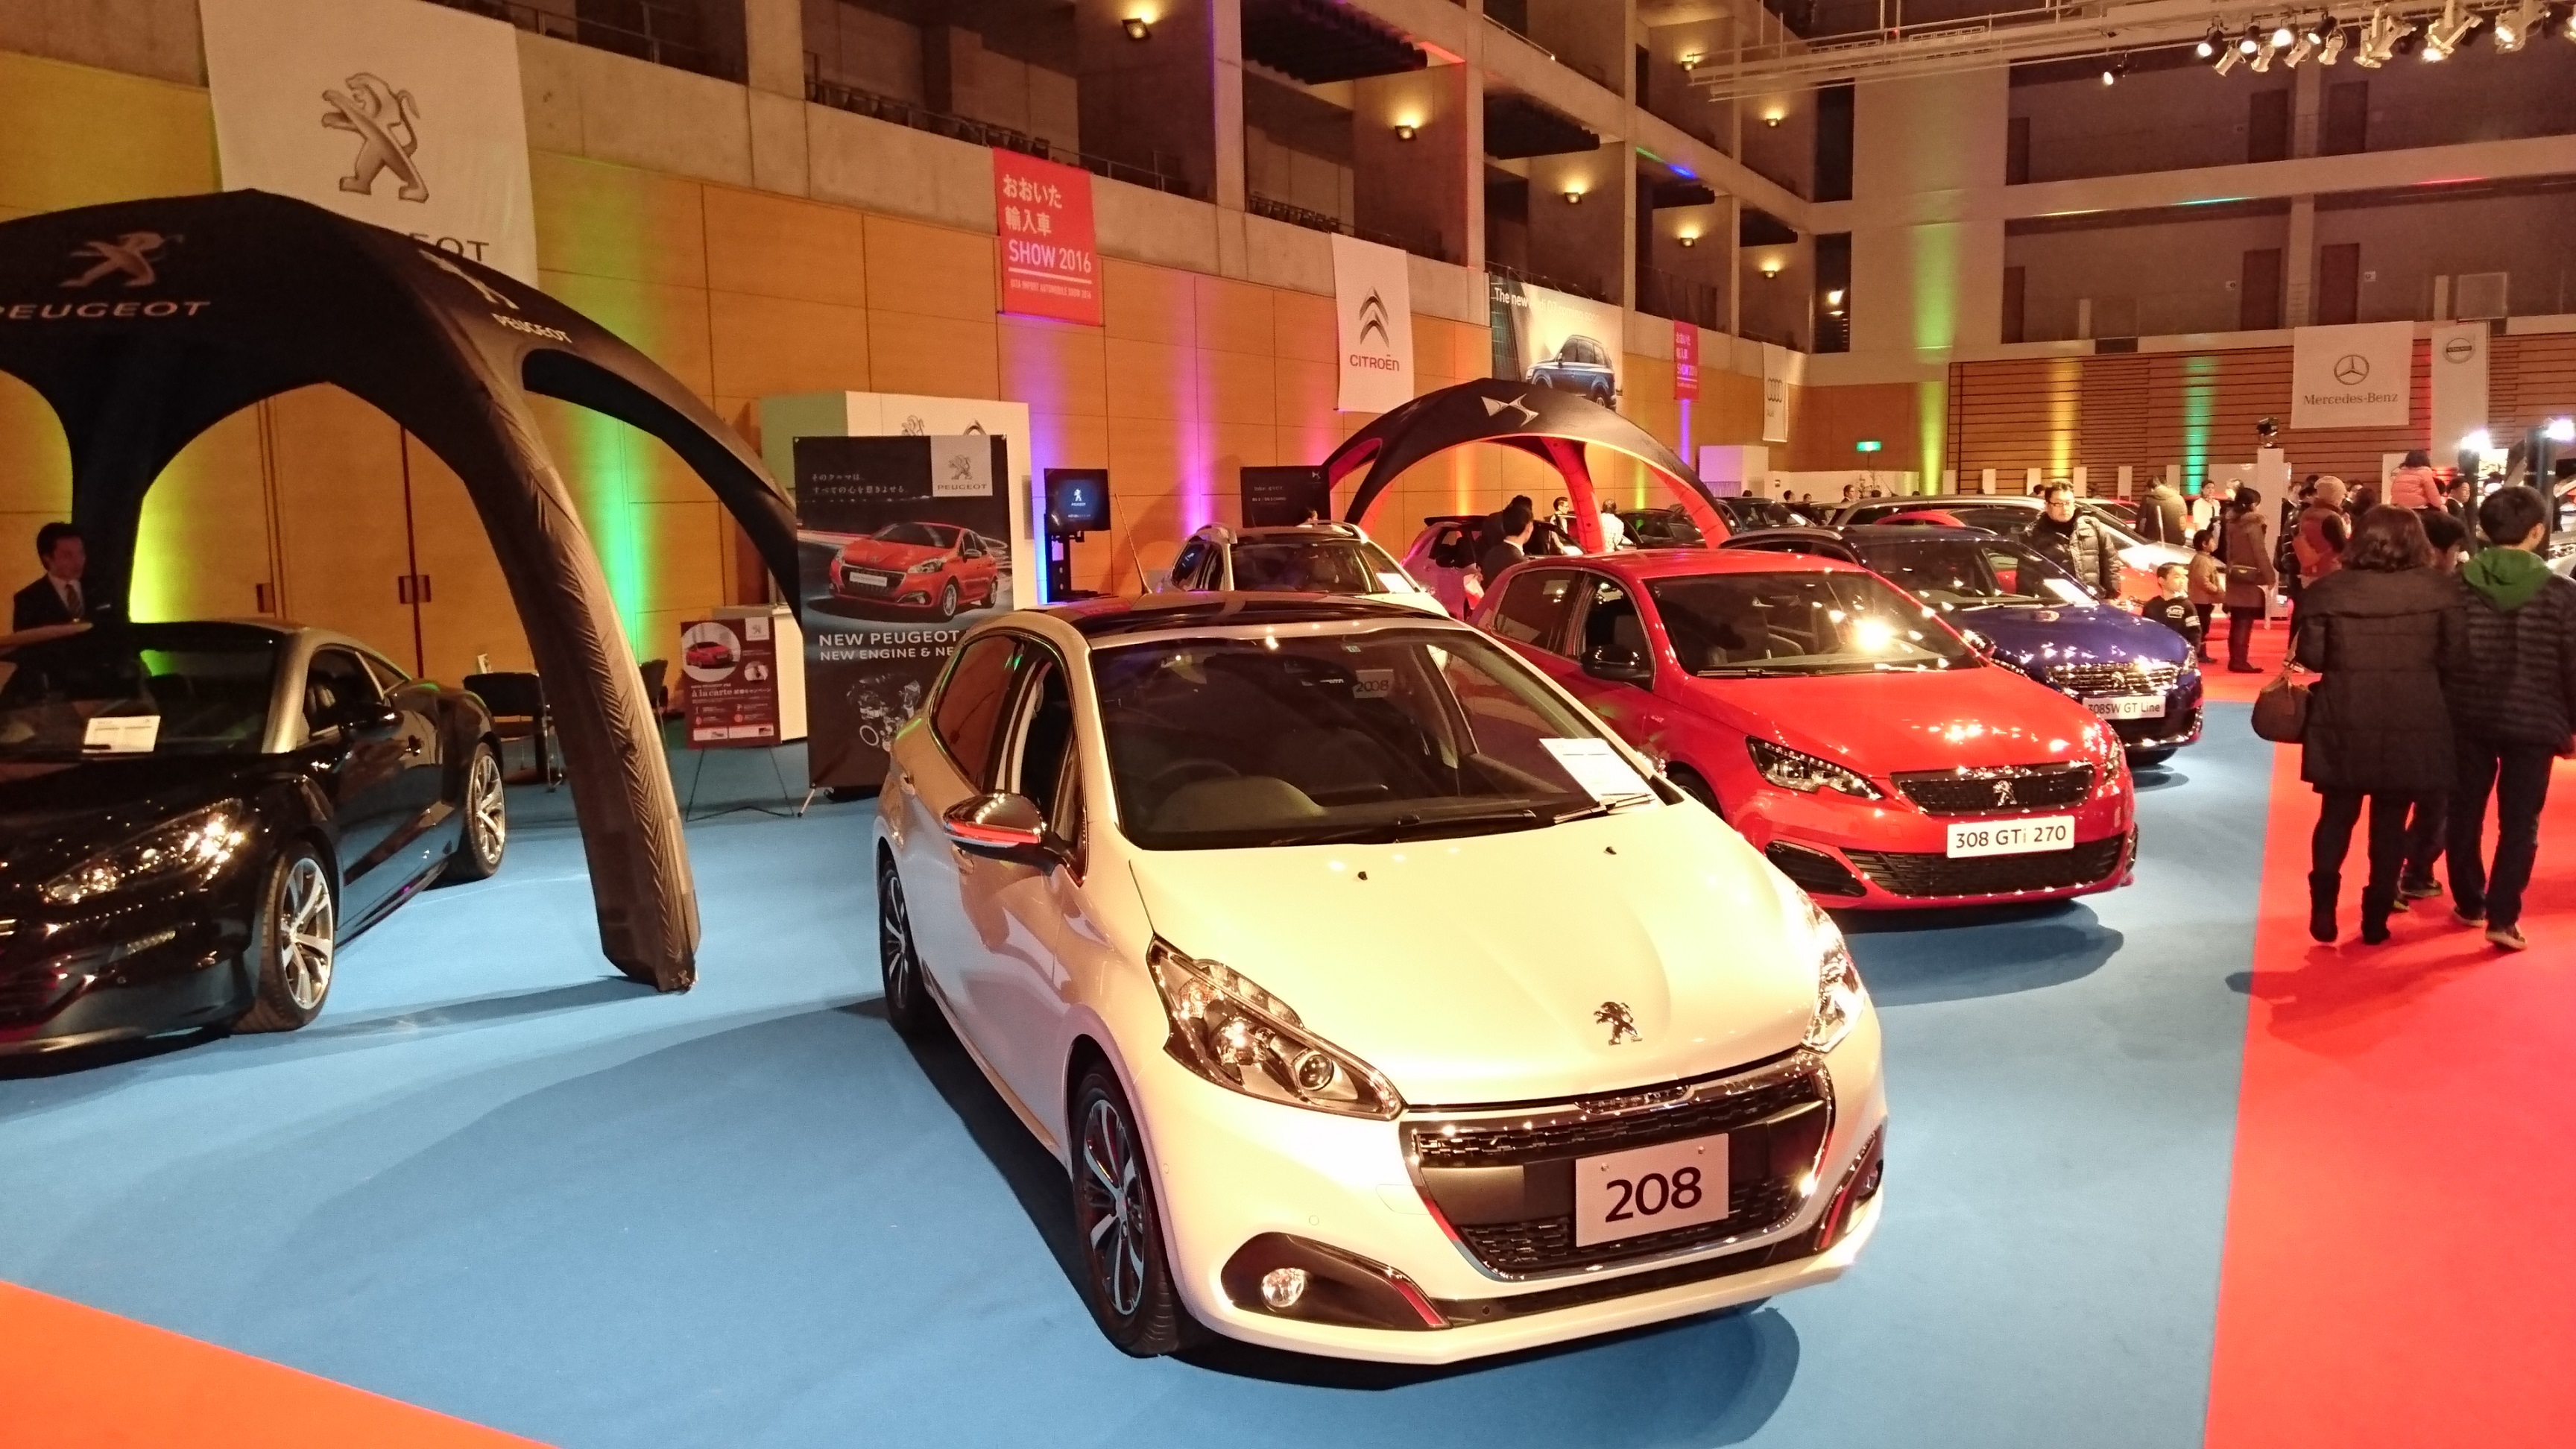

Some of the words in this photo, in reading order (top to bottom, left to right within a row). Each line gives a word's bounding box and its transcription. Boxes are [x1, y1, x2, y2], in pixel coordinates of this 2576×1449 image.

[1003, 174, 1062, 209] おおいた
[1005, 206, 1052, 236] 輸入車
[1008, 239, 1055, 268] SHOW
[1058, 247, 1092, 274] 2016
[1494, 287, 1510, 304] The
[1511, 294, 1529, 308] new
[0, 301, 211, 319] EUGEOT
[490, 312, 573, 344] PEUGEOT
[2304, 392, 2399, 405] Mercedes-Benz
[819, 634, 864, 646] NEW
[871, 630, 960, 645] PEUGEOT
[821, 650, 855, 661] NEW
[859, 648, 916, 660] ENGINE
[921, 647, 931, 657] &
[709, 689, 733, 697] carte
[1356, 679, 1389, 692] 2008
[2088, 703, 2122, 715] 308SW
[2124, 703, 2138, 713] GT
[2141, 702, 2161, 713] Line
[1956, 831, 1989, 849] 308
[1995, 828, 2027, 845] GTi
[2033, 825, 2066, 842] 270
[1605, 1167, 1702, 1222] 208
